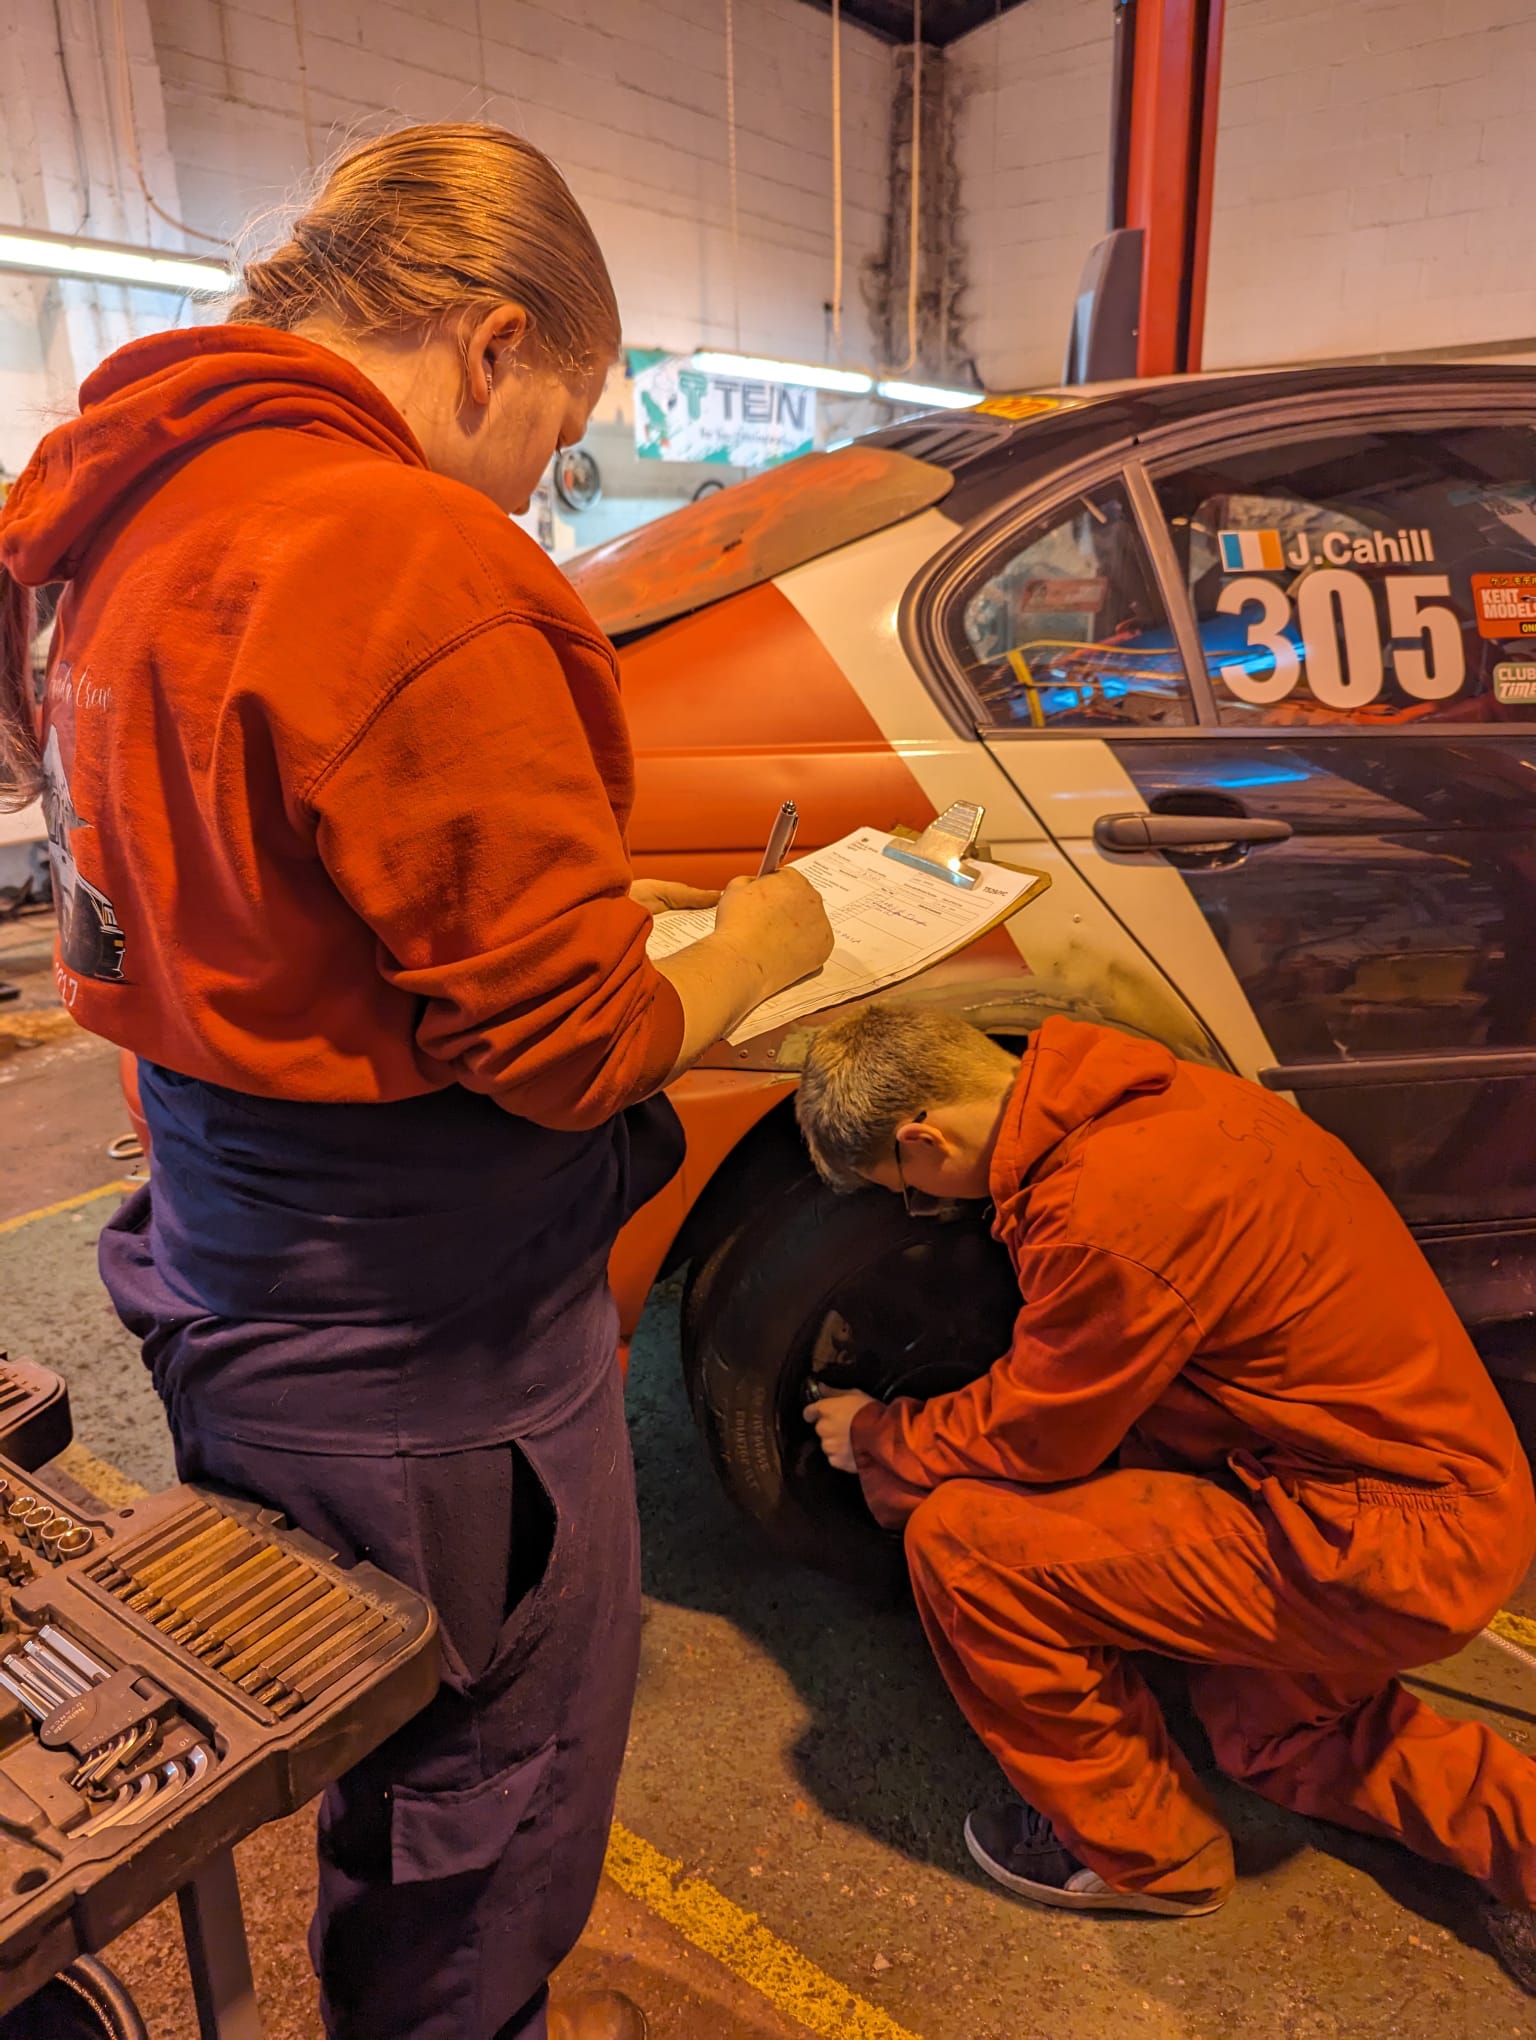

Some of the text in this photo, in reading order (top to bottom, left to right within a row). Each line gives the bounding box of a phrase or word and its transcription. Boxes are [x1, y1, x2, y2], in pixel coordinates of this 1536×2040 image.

[1287, 528, 1436, 566] J.Cahill
[1481, 588, 1519, 603] KENT
[1215, 568, 1467, 710] 305
[1498, 667, 1536, 681] CLUB
